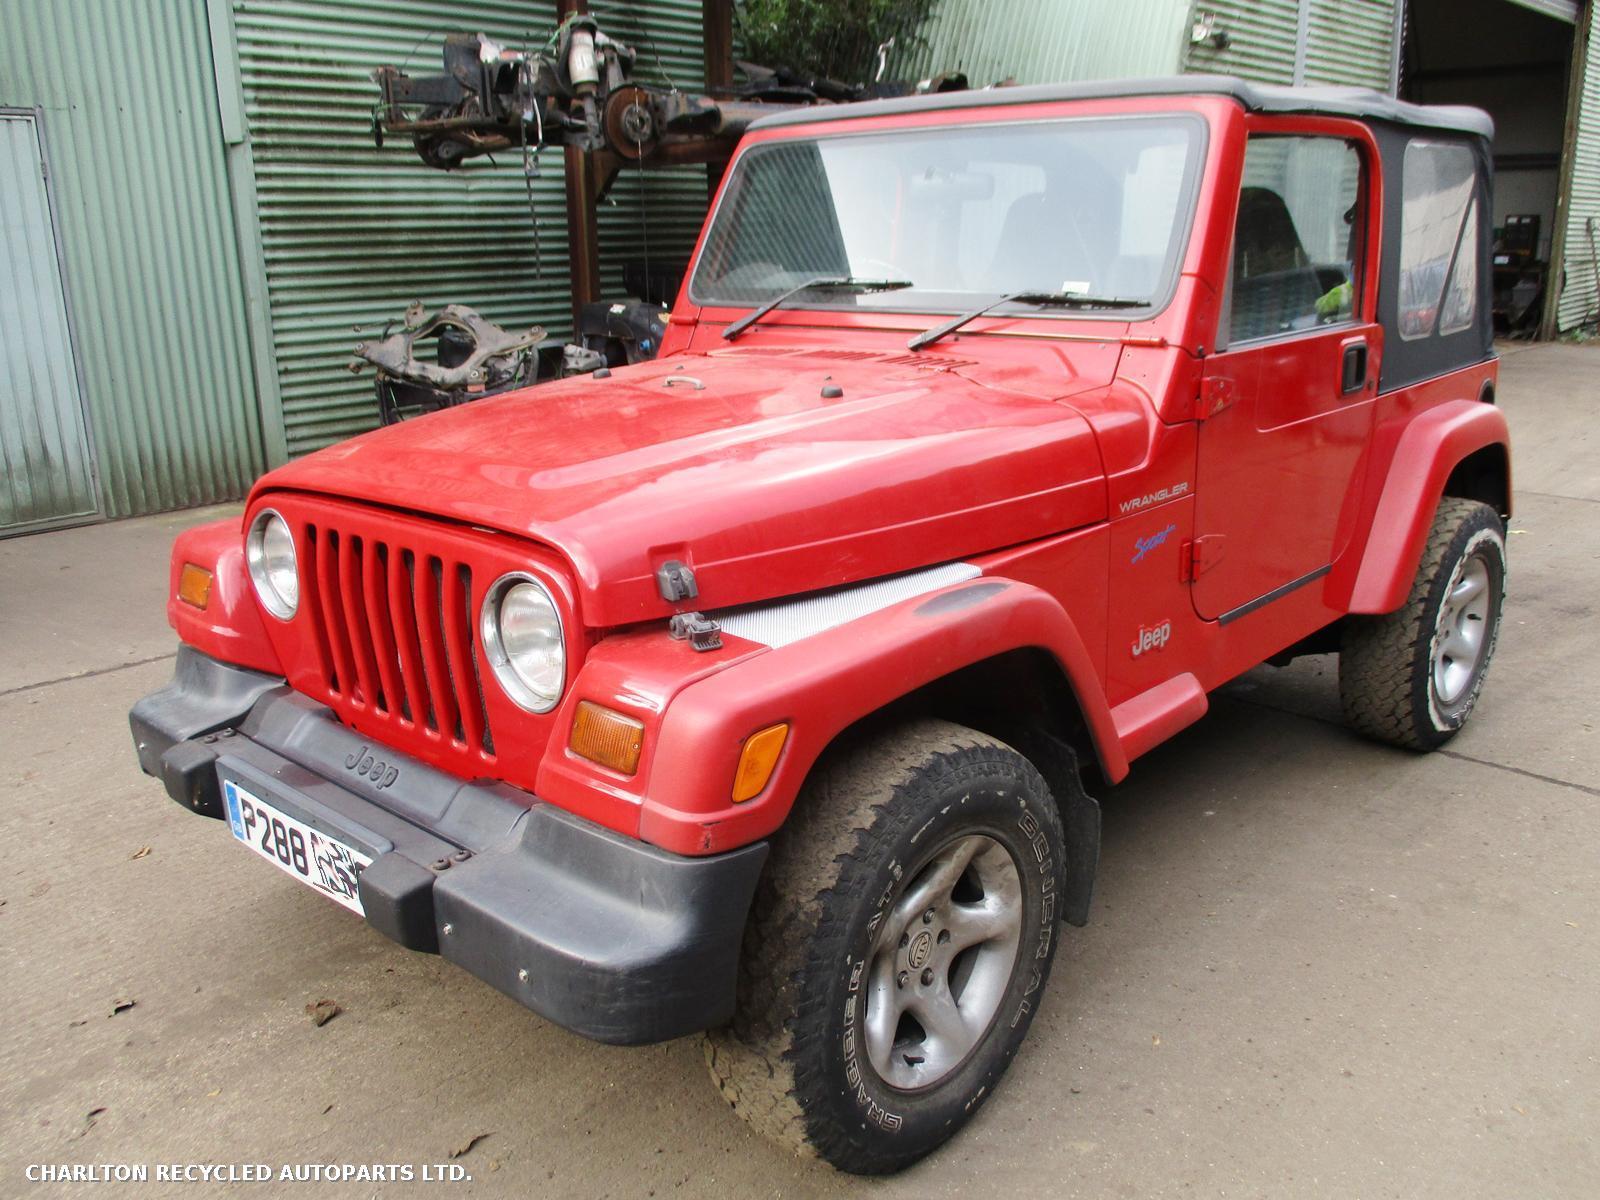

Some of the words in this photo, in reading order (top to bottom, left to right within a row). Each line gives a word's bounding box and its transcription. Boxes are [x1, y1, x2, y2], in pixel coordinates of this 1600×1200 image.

[1119, 482, 1189, 512] WRANGLER
[1132, 621, 1172, 656] Jeep
[345, 746, 399, 790] Jeep
